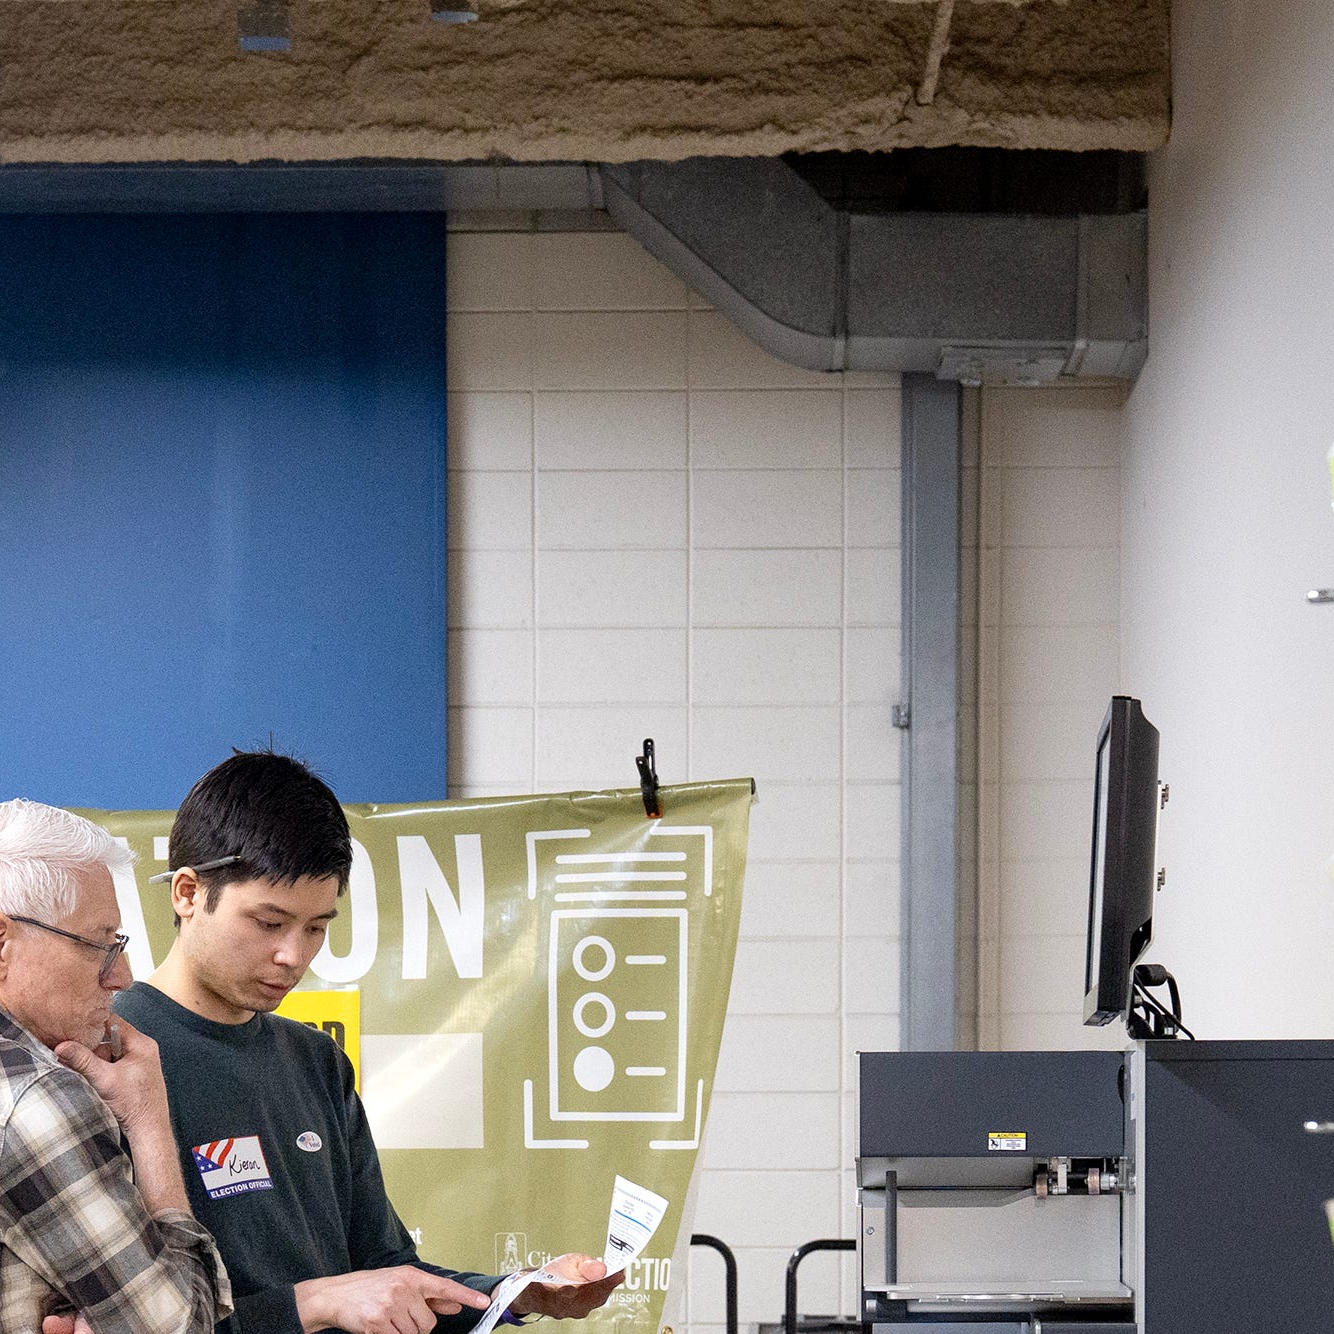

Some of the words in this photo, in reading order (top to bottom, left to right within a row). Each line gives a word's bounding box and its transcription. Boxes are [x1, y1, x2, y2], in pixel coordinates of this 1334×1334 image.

[229, 1154, 260, 1176] Kieran
[210, 1183, 249, 1199] ELECTION
[249, 1179, 272, 1190] OFFICIAL
[527, 1251, 551, 1267] Cit
[608, 1293, 651, 1304] MISSION
